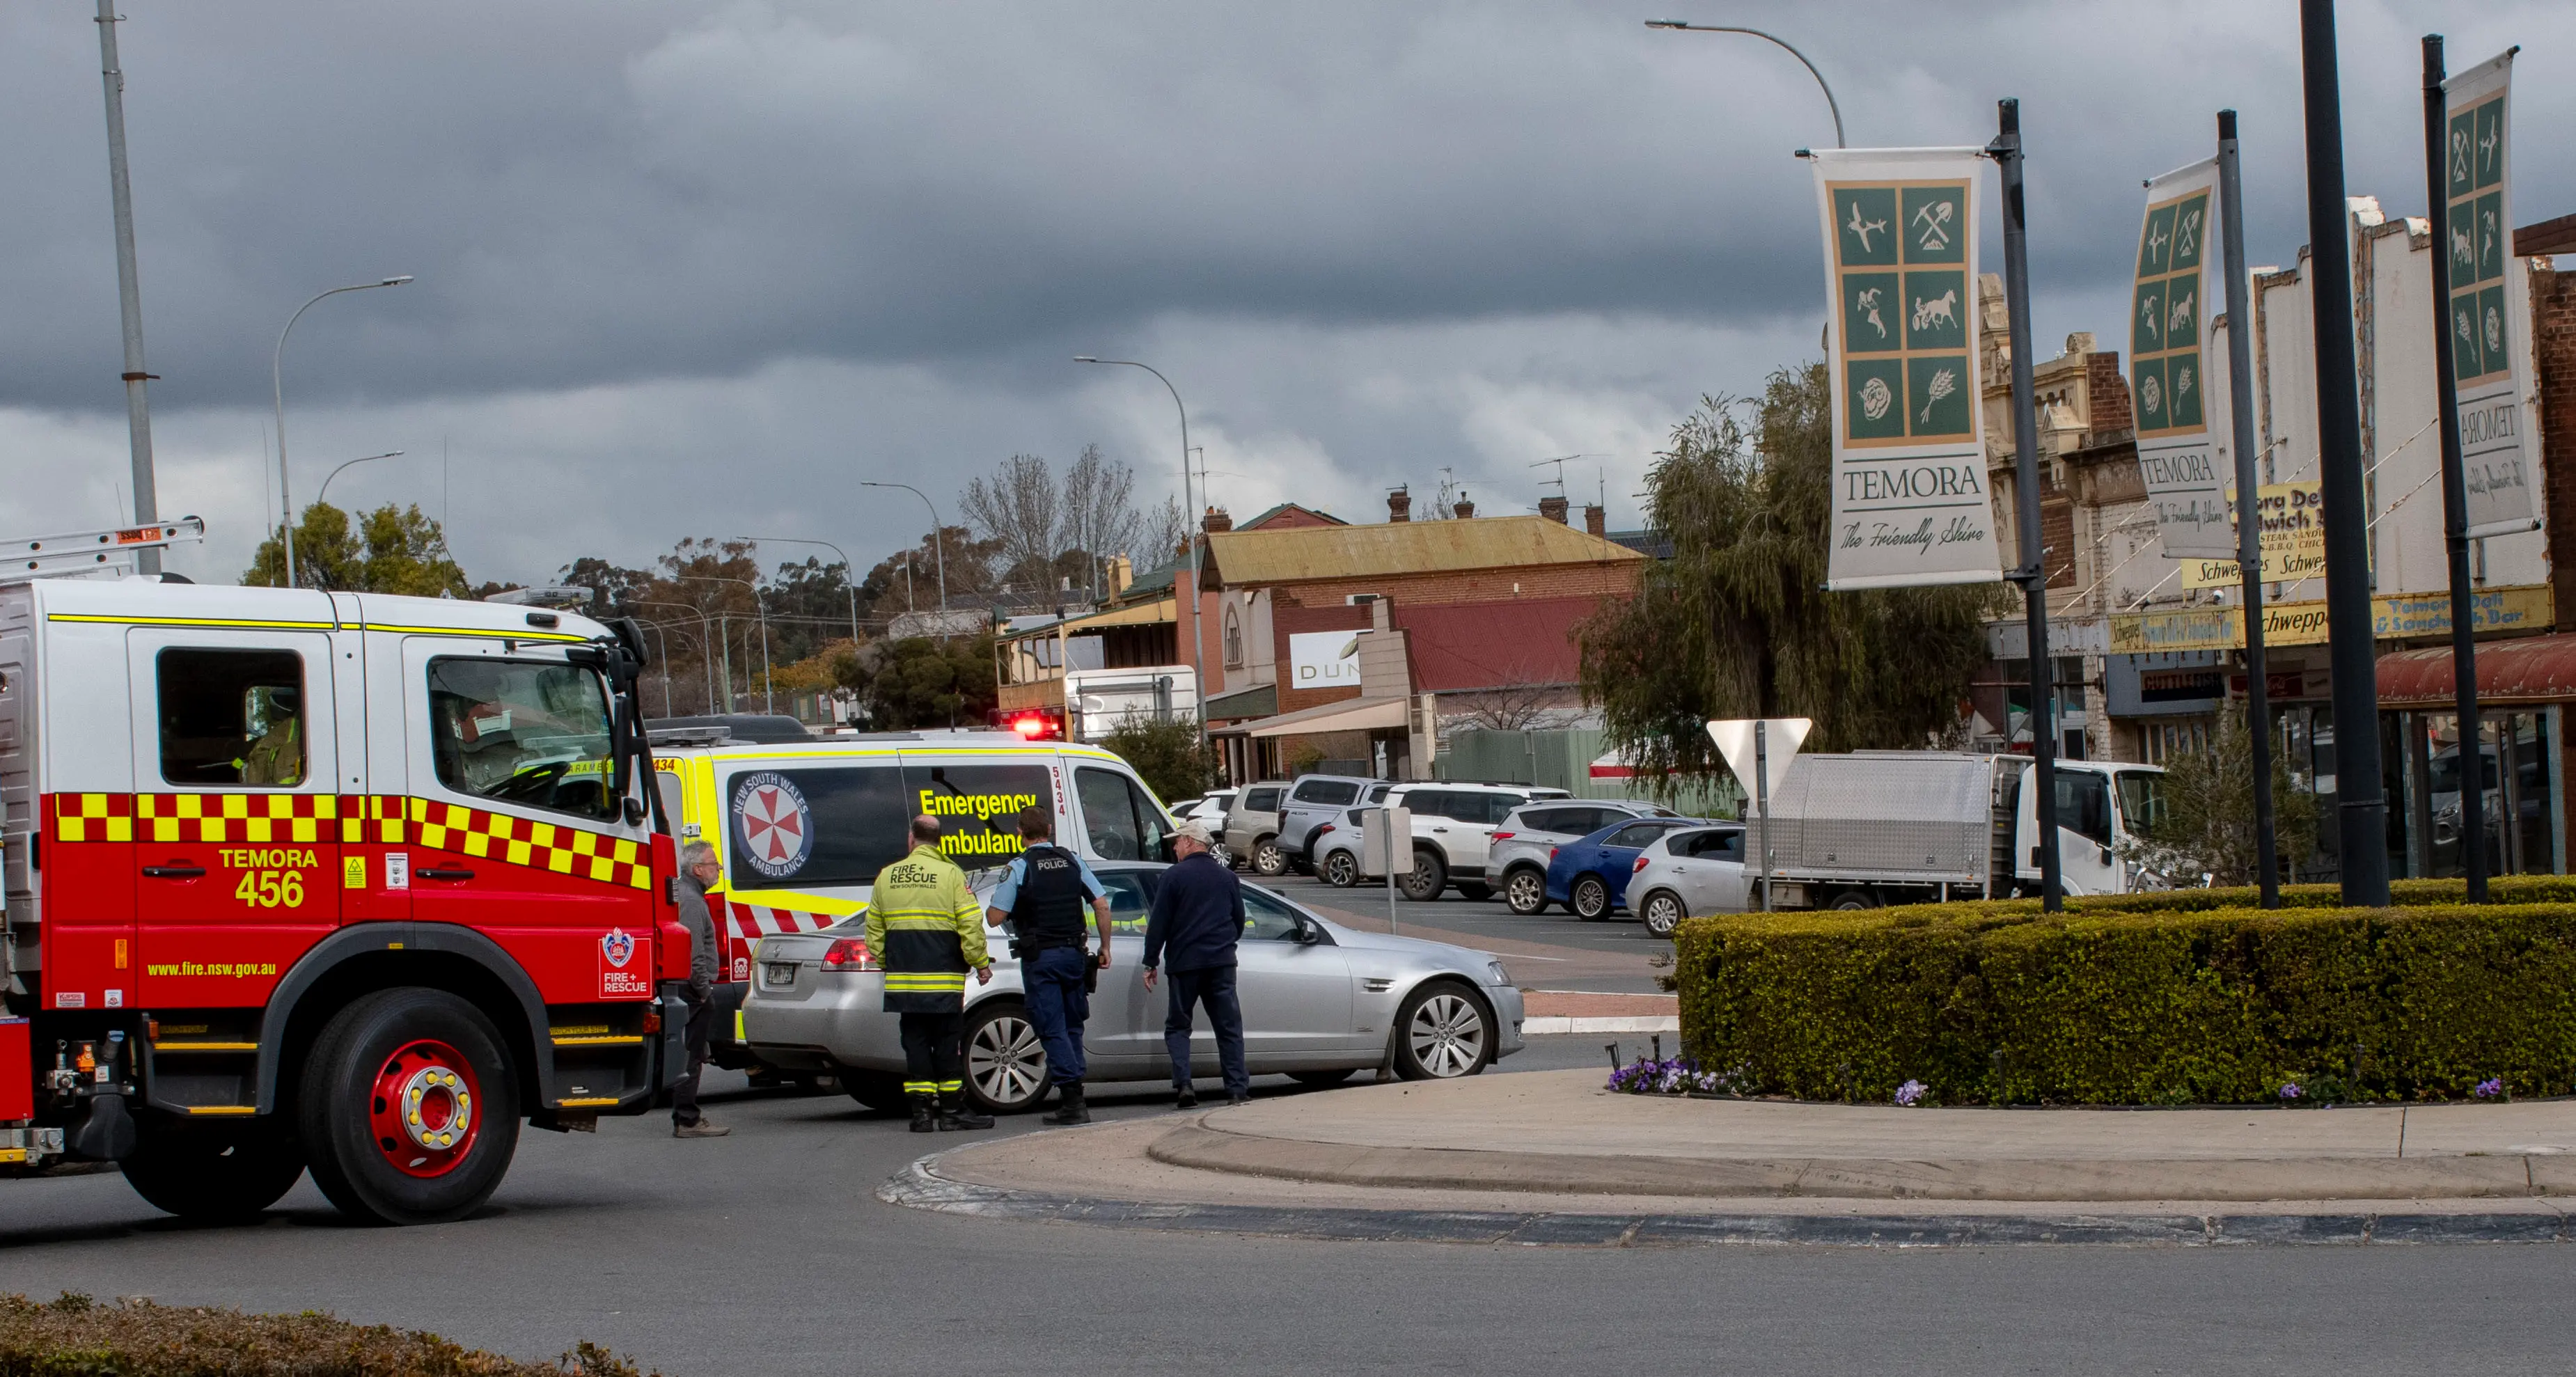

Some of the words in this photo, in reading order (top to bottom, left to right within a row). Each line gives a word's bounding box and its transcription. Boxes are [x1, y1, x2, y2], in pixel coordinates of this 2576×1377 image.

[2142, 454, 2215, 485] TEMORA
[1842, 465, 1982, 501] TEMORA
[2291, 487, 2323, 507] De
[1840, 521, 1864, 549] The
[1870, 517, 1935, 556] Friendly
[1938, 515, 1985, 546] Shire
[2260, 533, 2288, 542] STEAK
[2298, 540, 2325, 549] CHIC
[2280, 555, 2325, 574] Schwe
[2387, 599, 2450, 614] Temor
[2144, 672, 2224, 689] CUTTLEFISH
[733, 786, 748, 815] NEW
[746, 773, 778, 790] SOUTH
[780, 777, 808, 814] WALES
[919, 789, 1036, 821] Emergency
[937, 828, 1027, 855] mbulanc
[219, 849, 318, 867] TEMORA
[748, 851, 807, 876] AMBULANCE
[1037, 860, 1069, 870] POLICE
[890, 873, 938, 883] RESCUE
[892, 864, 917, 874] FIRE
[235, 870, 304, 908] 456
[148, 961, 276, 978] www.fire.nsw.gov.au
[604, 973, 628, 982] FIRE
[604, 982, 647, 993] RESCUE
